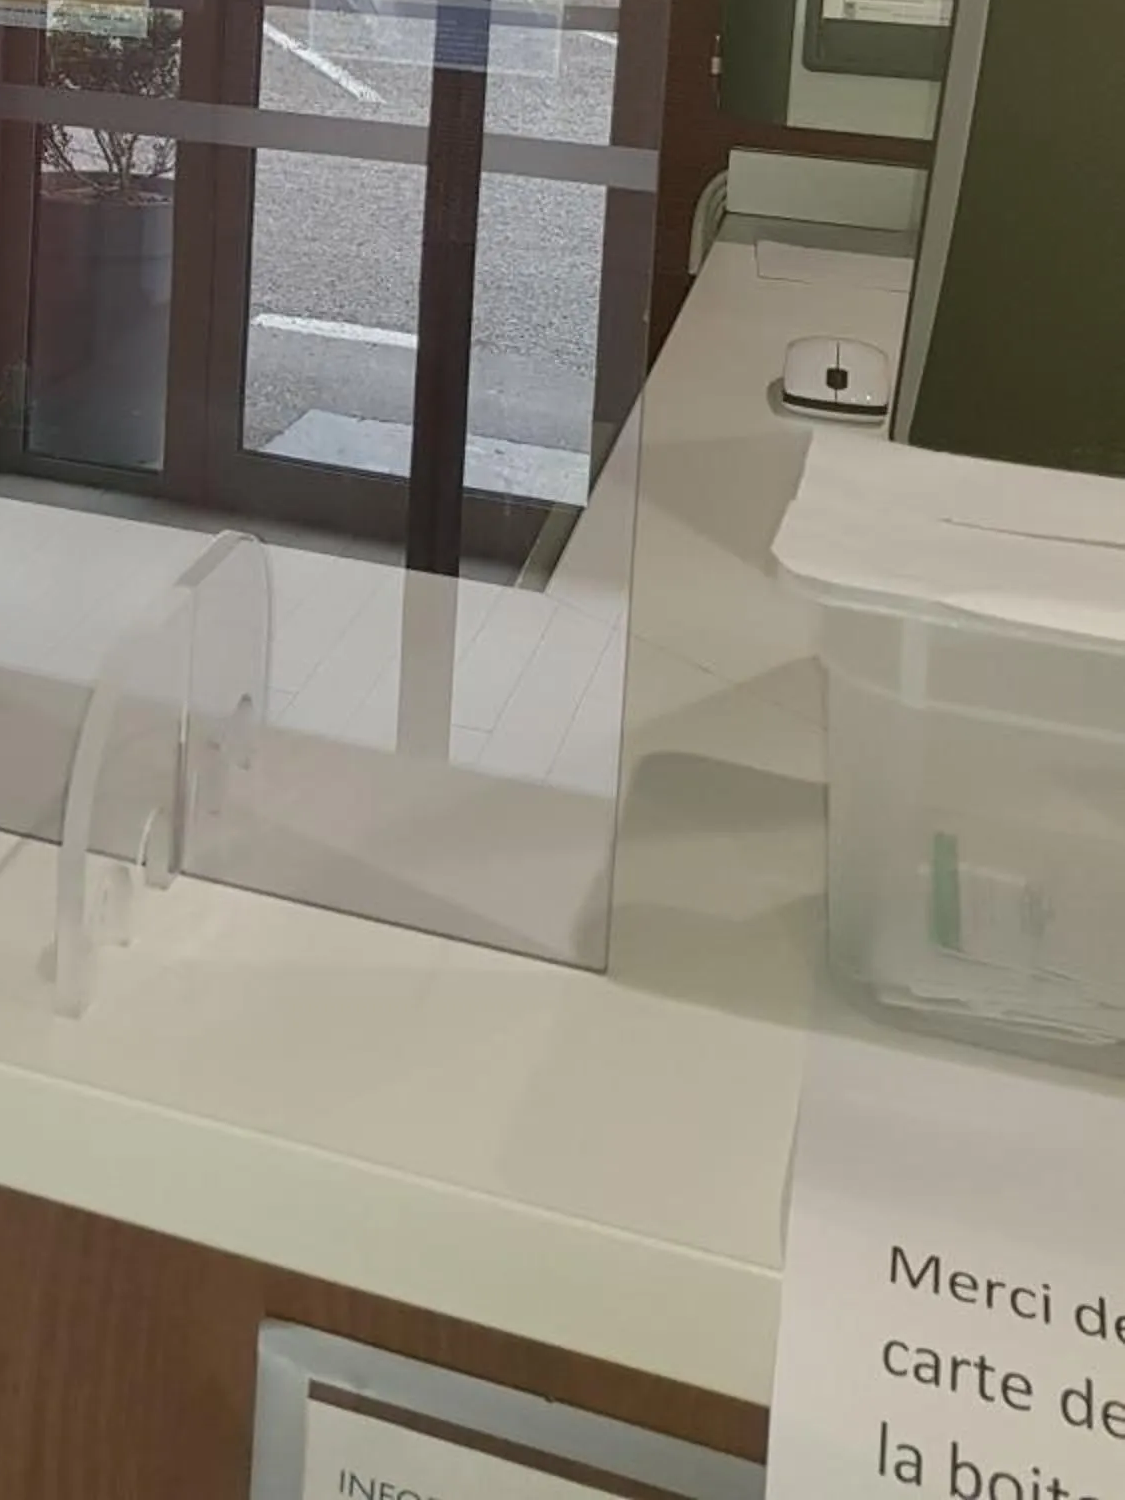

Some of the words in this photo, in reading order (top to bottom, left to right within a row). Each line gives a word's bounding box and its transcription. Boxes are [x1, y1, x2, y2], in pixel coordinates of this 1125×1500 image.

[890, 1245, 1051, 1325] Merci
[882, 1339, 1033, 1411] carte
[1060, 1377, 1125, 1440] de
[878, 1420, 922, 1487] la
[950, 1440, 1097, 1500] boit
